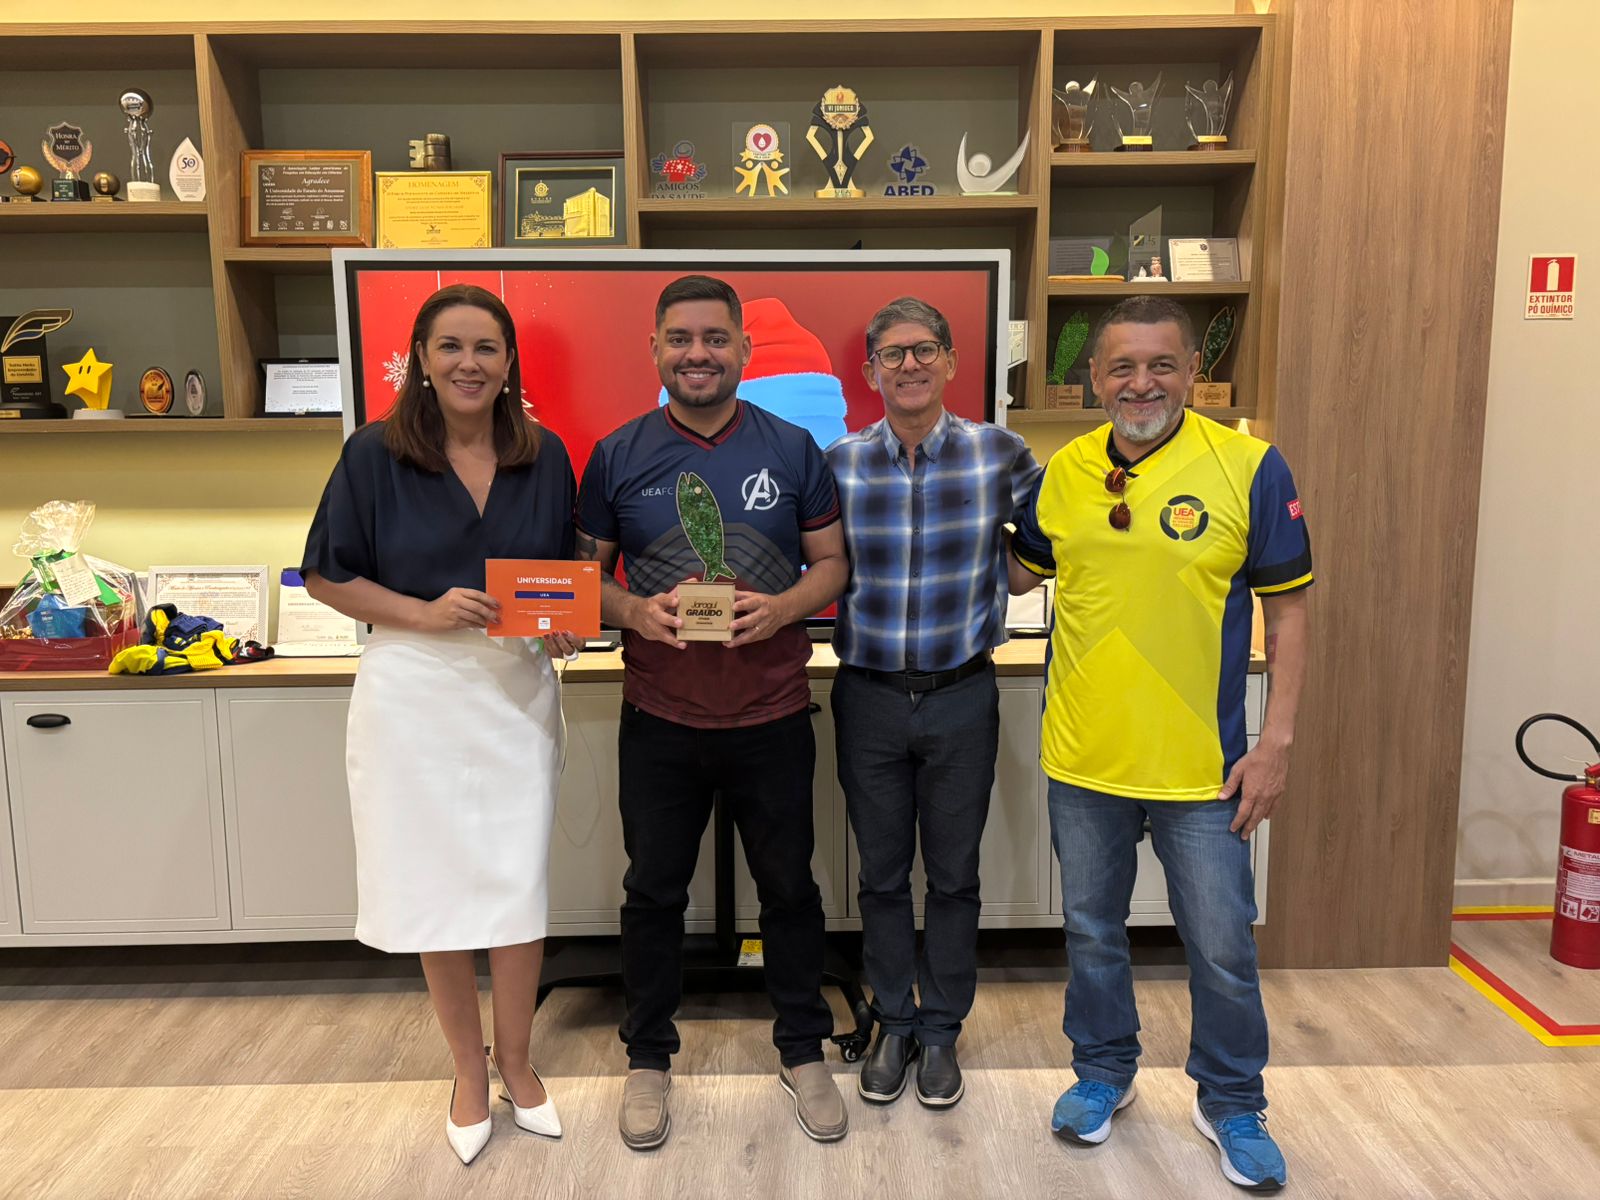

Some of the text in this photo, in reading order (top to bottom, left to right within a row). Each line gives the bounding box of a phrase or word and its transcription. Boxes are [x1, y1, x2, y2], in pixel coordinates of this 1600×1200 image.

[181, 157, 196, 169] 50
[301, 177, 330, 187] Agradece
[408, 180, 460, 188] HOMENAGEM
[656, 182, 700, 191] AMIGOS
[884, 185, 935, 197] ABED
[1529, 294, 1573, 303] EXTINTOR
[1527, 303, 1573, 314] PÓ QUÍMICO
[641, 486, 675, 497] UEAFC
[1173, 507, 1195, 516] UEA
[516, 576, 573, 585] UNIVERSIDADE
